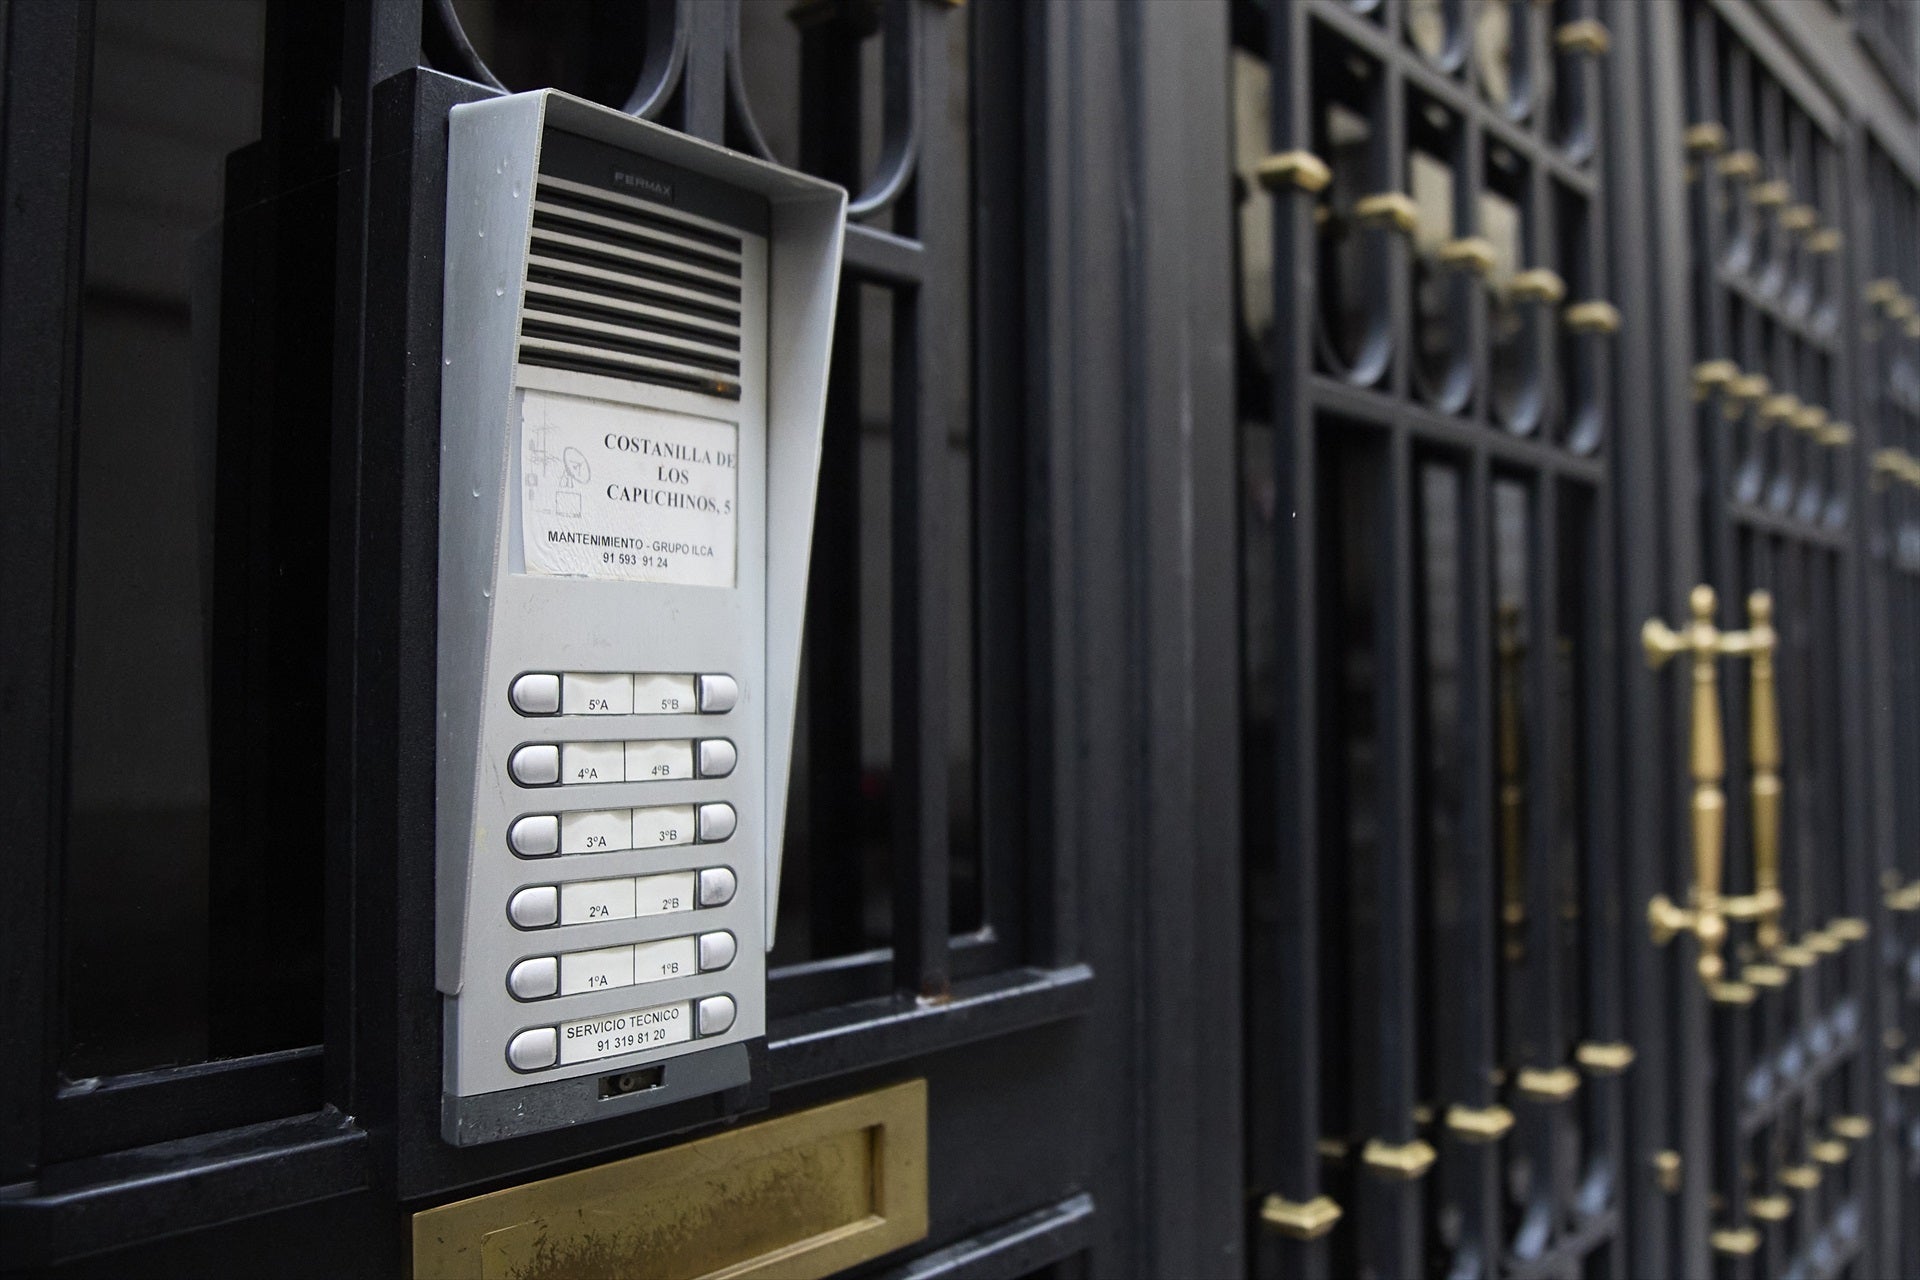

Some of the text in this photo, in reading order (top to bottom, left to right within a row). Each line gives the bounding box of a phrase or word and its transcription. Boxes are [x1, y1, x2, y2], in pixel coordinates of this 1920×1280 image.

[604, 433, 736, 469] COSTANILLA DE
[657, 466, 690, 485] LOS
[606, 483, 732, 515] CAPUCHINOS, 5
[547, 530, 644, 550] MANTENIMIENTO
[652, 541, 690, 555] GRUPO
[692, 545, 714, 557] ILCA
[602, 552, 668, 568] 91 593 91 24
[566, 1008, 680, 1039] SERVICIO TECNICO
[597, 1028, 666, 1052] 91 319 81 20
